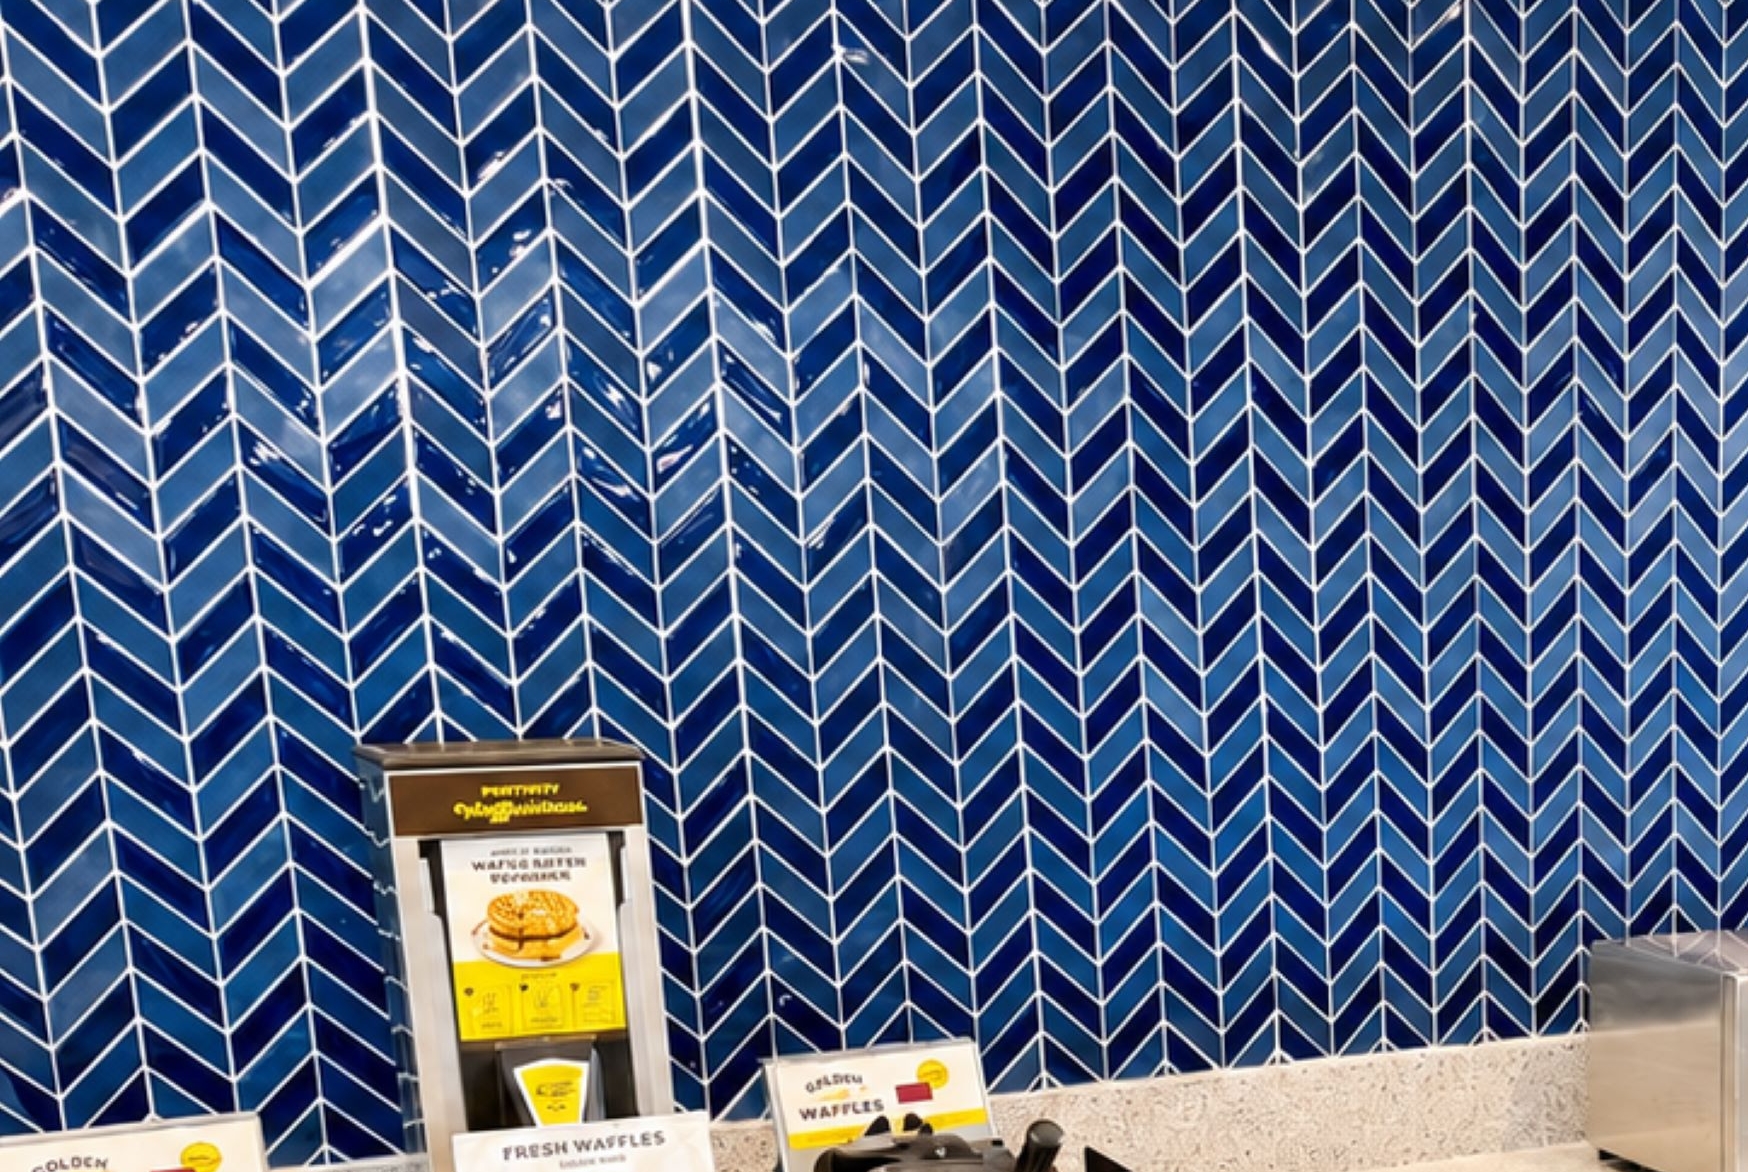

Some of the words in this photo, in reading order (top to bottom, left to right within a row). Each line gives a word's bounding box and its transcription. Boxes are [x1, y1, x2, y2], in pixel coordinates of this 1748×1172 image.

[799, 1099, 884, 1121] WAFFLES
[502, 1140, 568, 1161] FRESH
[573, 1130, 666, 1153] WAFFLES
